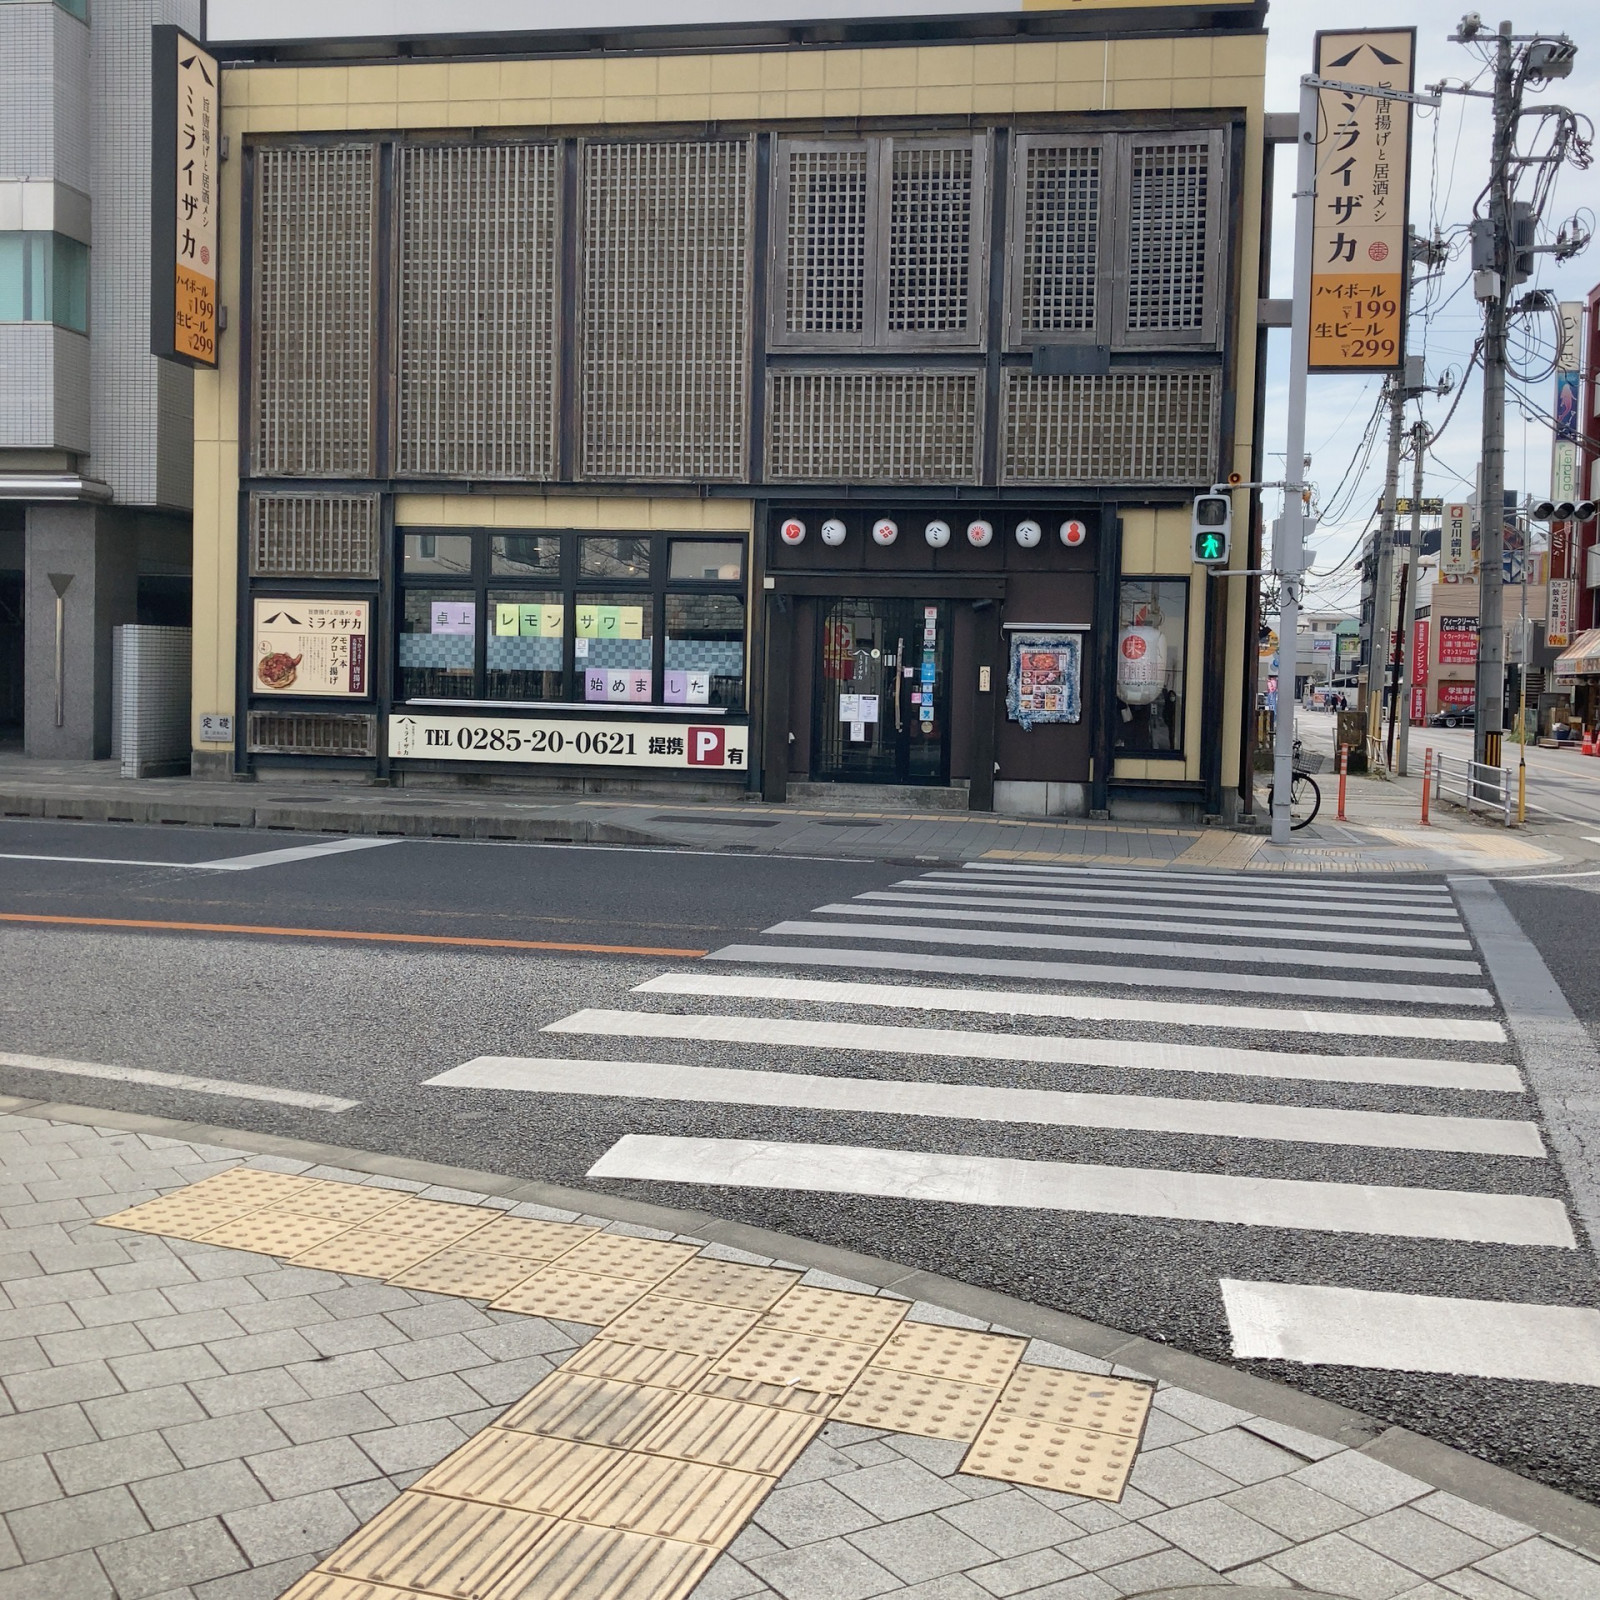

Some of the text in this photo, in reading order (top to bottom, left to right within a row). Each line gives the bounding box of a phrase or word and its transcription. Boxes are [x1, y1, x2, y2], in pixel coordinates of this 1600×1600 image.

[181, 85, 198, 259] ミライザカ
[1327, 91, 1364, 263] ミライザカ
[176, 276, 208, 298] ハイボール
[1316, 284, 1387, 299] ハイボール
[176, 312, 208, 333] 生ビール
[1315, 322, 1385, 338] 生ビール
[1451, 519, 1462, 557] 石川歯科
[308, 617, 362, 630] ミライザカ
[436, 611, 471, 627] 卓上
[501, 612, 562, 630] レモン
[580, 615, 640, 631] サワー
[329, 636, 339, 686] グローブ揚げ
[339, 636, 348, 669] モモ一本
[590, 677, 706, 695] 始めました
[203, 717, 230, 729] 定礎
[425, 729, 453, 746] TEL
[457, 728, 637, 755] 0285-20-0621
[648, 732, 744, 765] 提携 P 有
